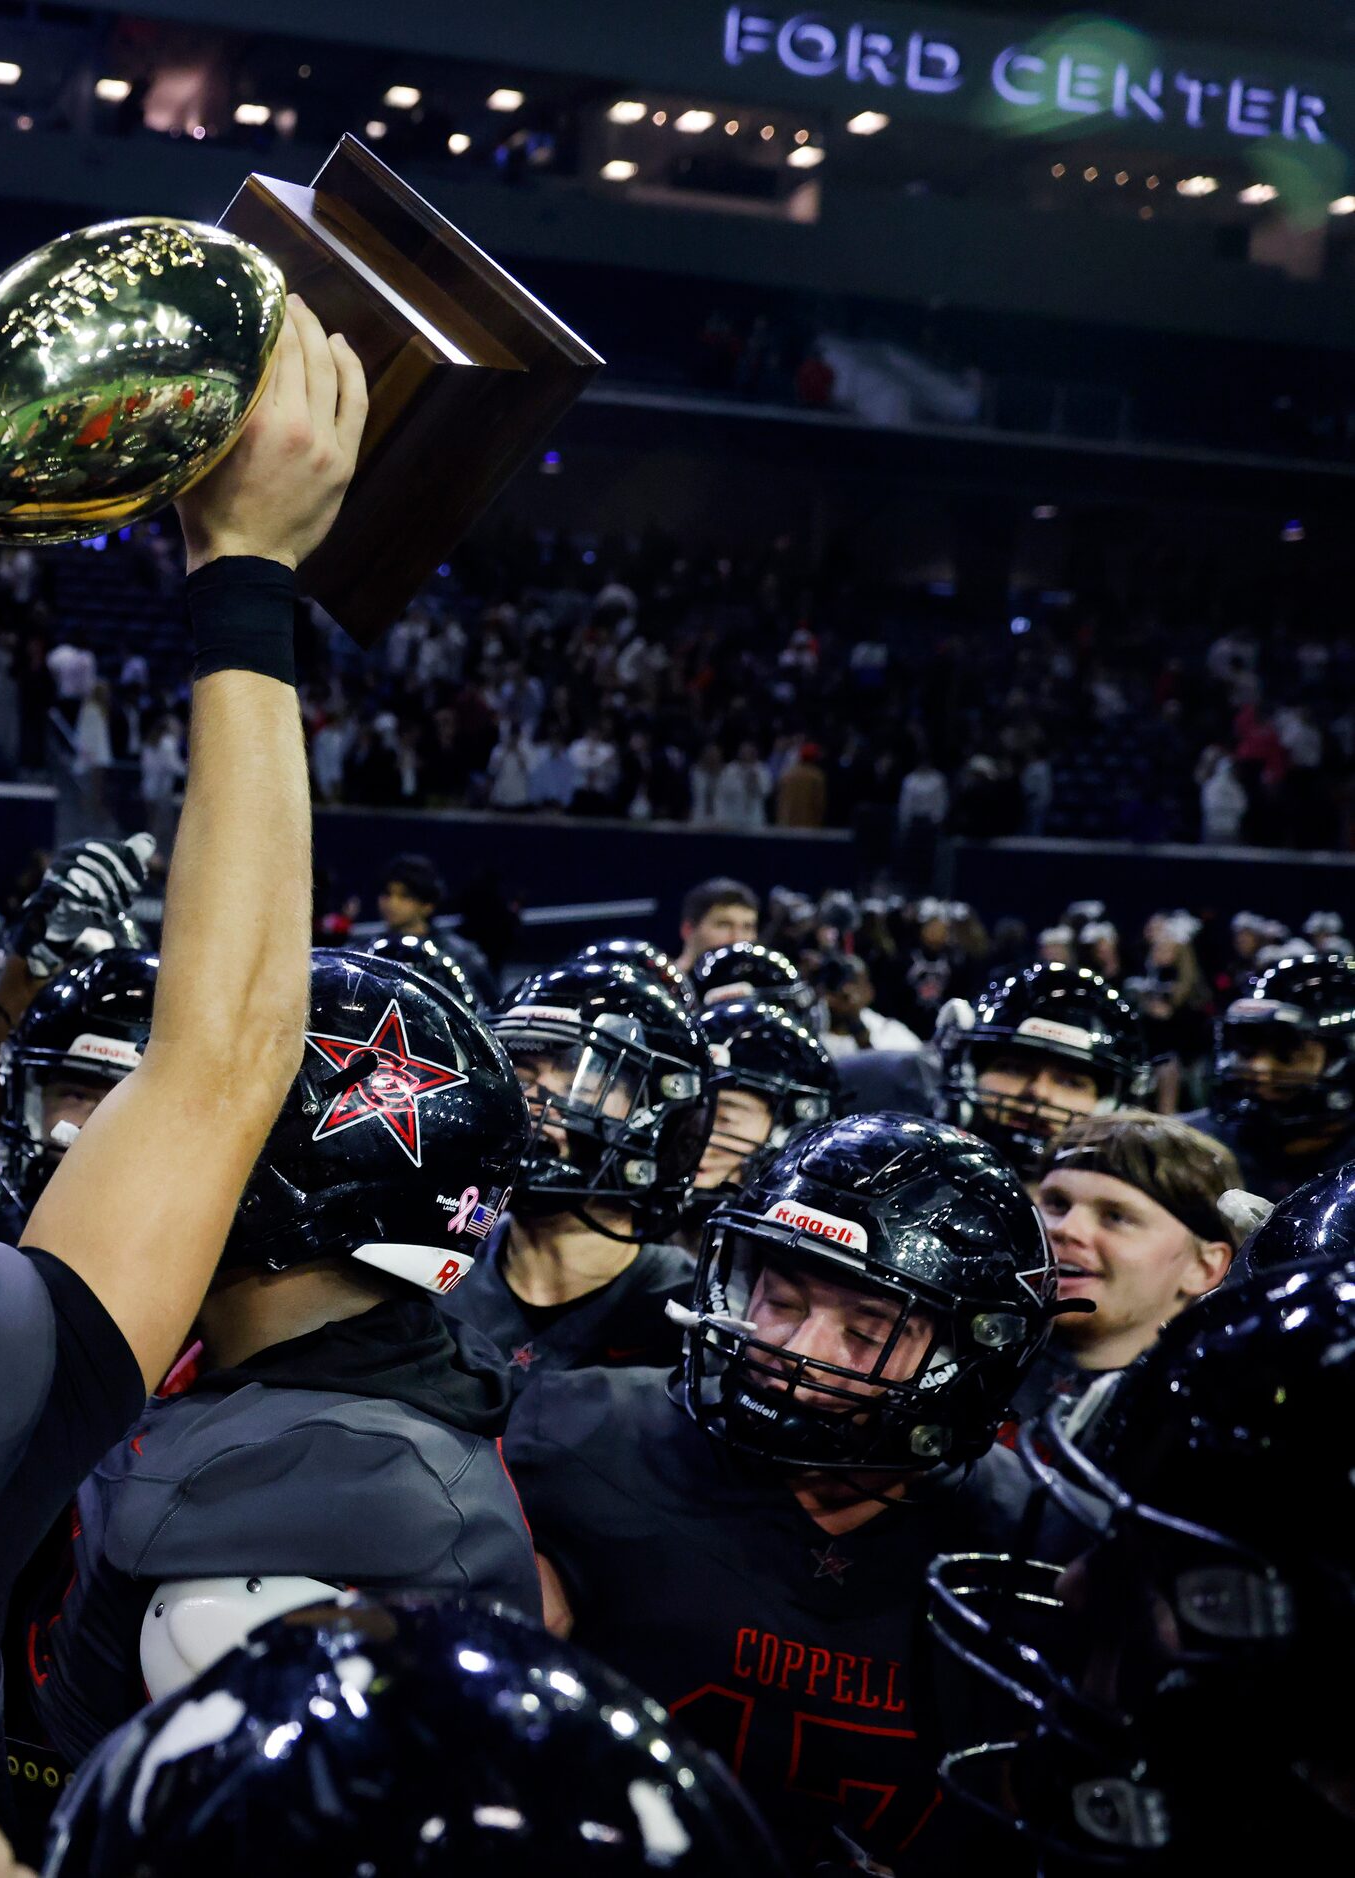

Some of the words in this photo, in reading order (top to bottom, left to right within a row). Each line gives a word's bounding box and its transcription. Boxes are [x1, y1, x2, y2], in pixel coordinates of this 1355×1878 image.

[723, 4, 964, 95] FORD
[991, 42, 1328, 145] CENTER
[739, 1394, 779, 1420] Riddell
[732, 1626, 908, 1713] COPPELL
